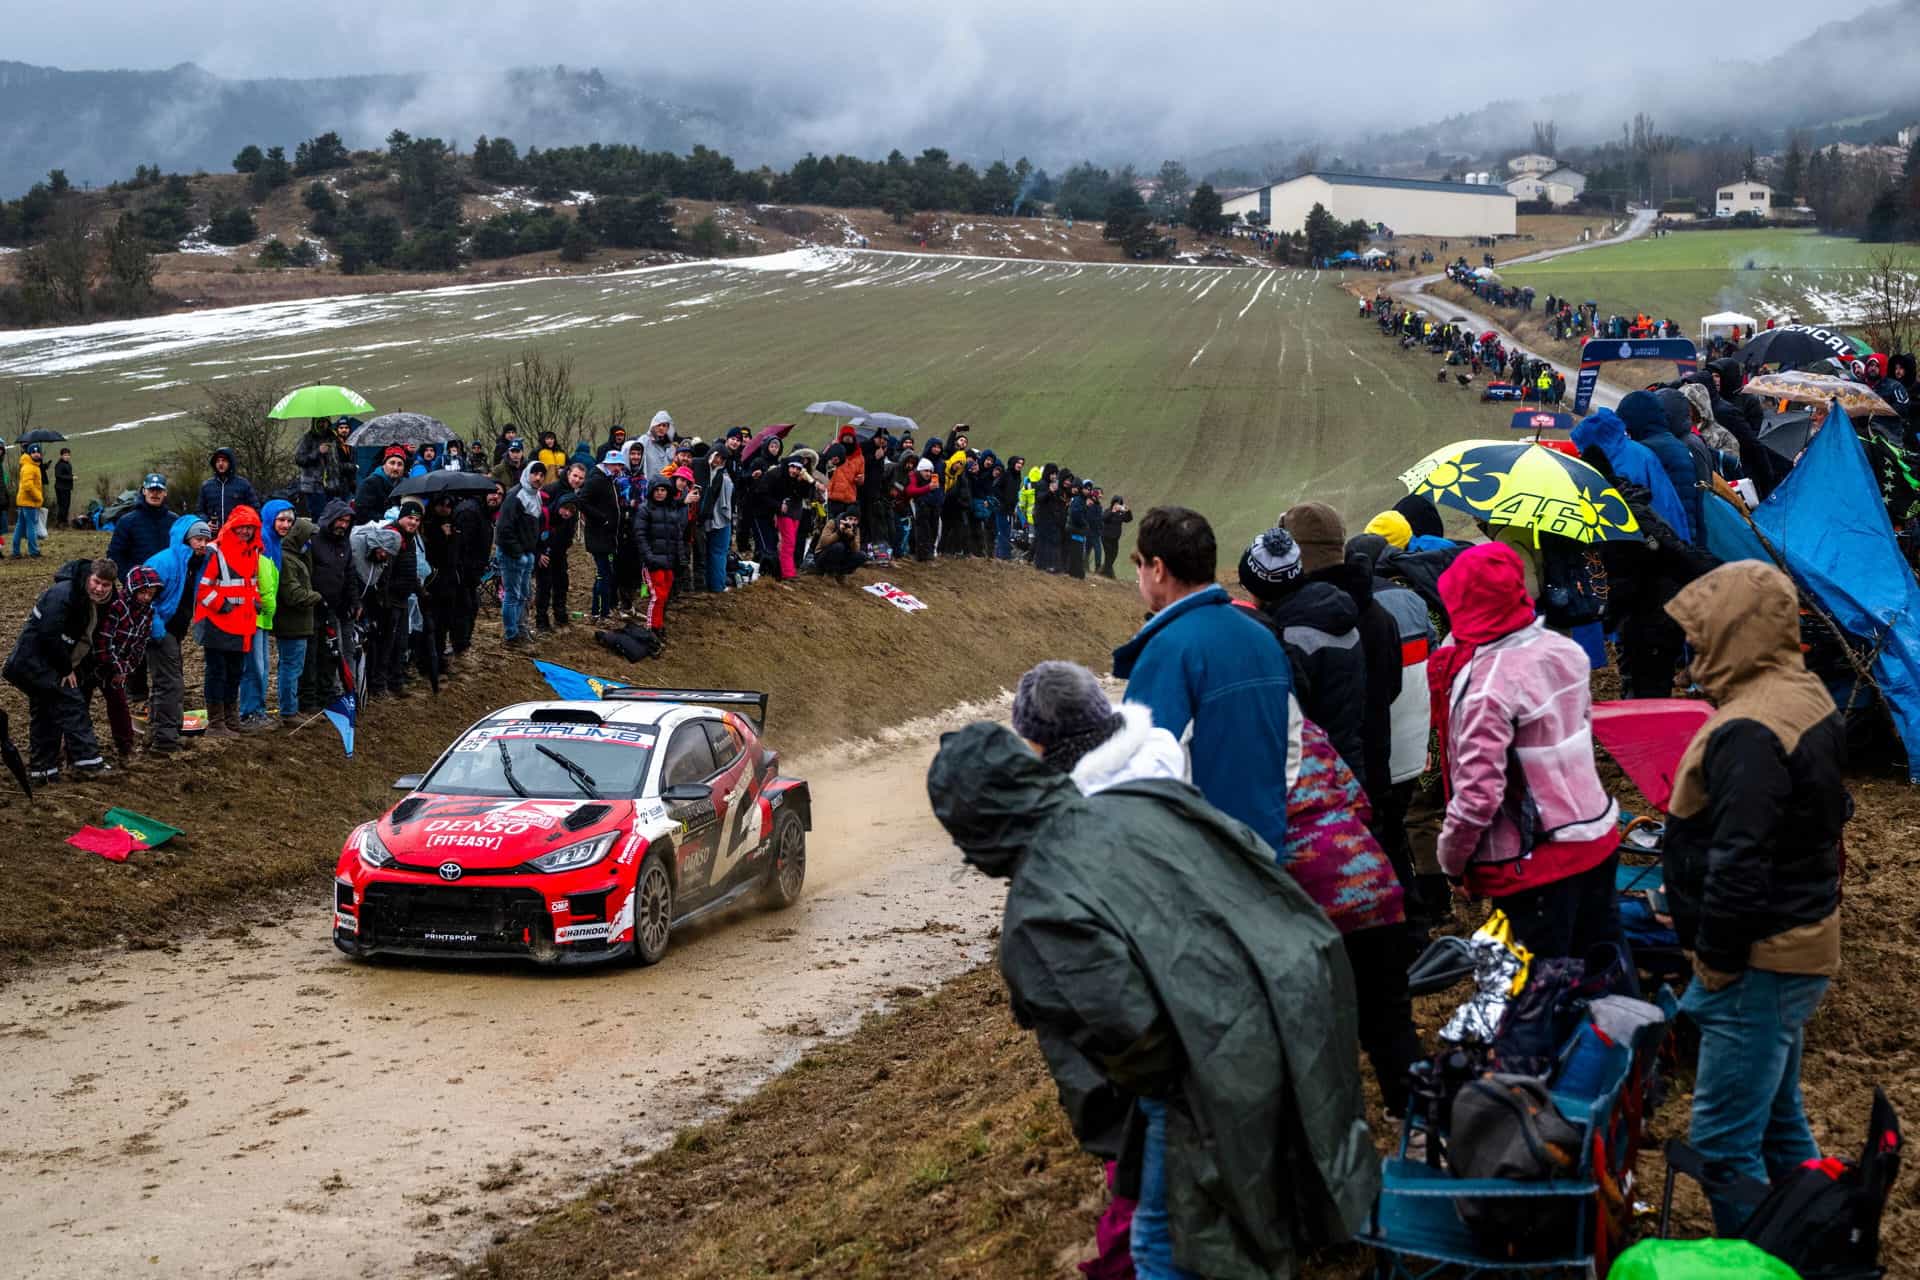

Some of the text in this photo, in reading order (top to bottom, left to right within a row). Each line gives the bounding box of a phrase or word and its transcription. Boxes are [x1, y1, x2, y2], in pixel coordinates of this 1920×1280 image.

[1489, 492, 1588, 541] 46
[424, 820, 530, 835] DENSO
[551, 901, 569, 912] OMP
